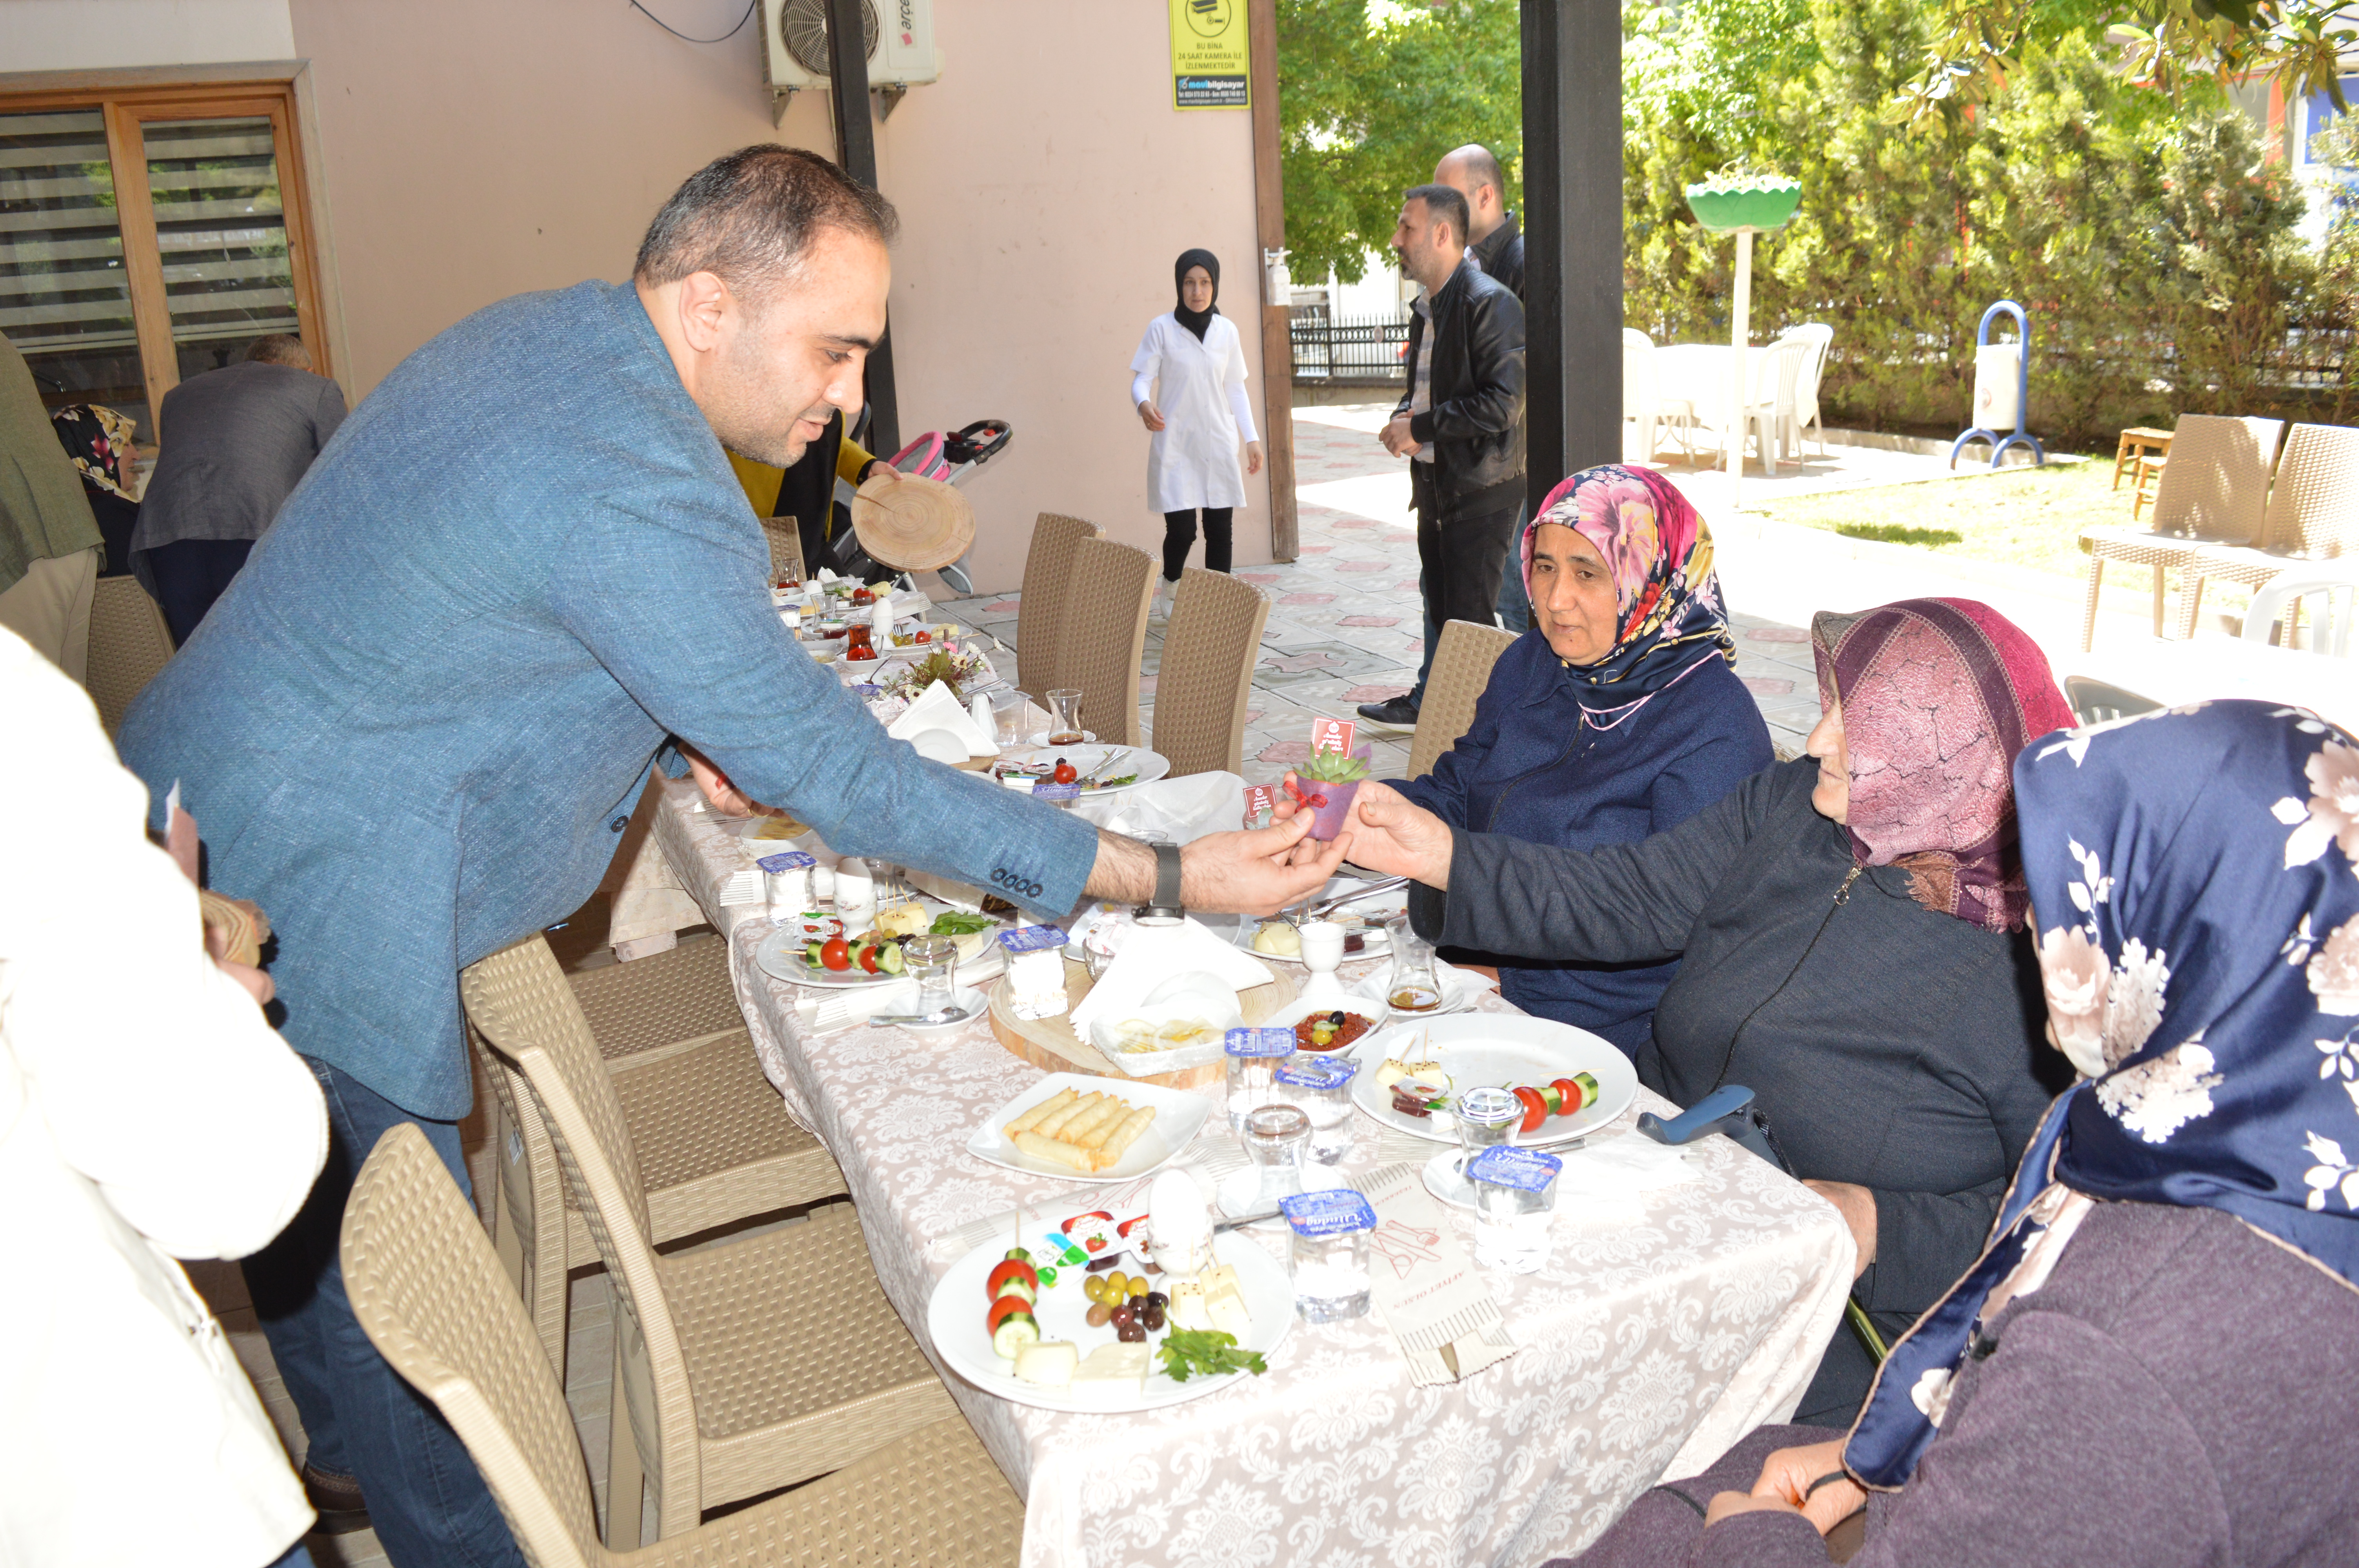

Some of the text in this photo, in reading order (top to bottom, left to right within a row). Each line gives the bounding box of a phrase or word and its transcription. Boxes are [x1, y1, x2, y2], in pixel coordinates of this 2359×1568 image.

[1207, 41, 1223, 49] BİNA
[1234, 51, 1242, 59] İLE
[1186, 60, 1236, 69] İZLENMEKTEDİR
[1393, 1290, 1427, 1310] OLSUN
